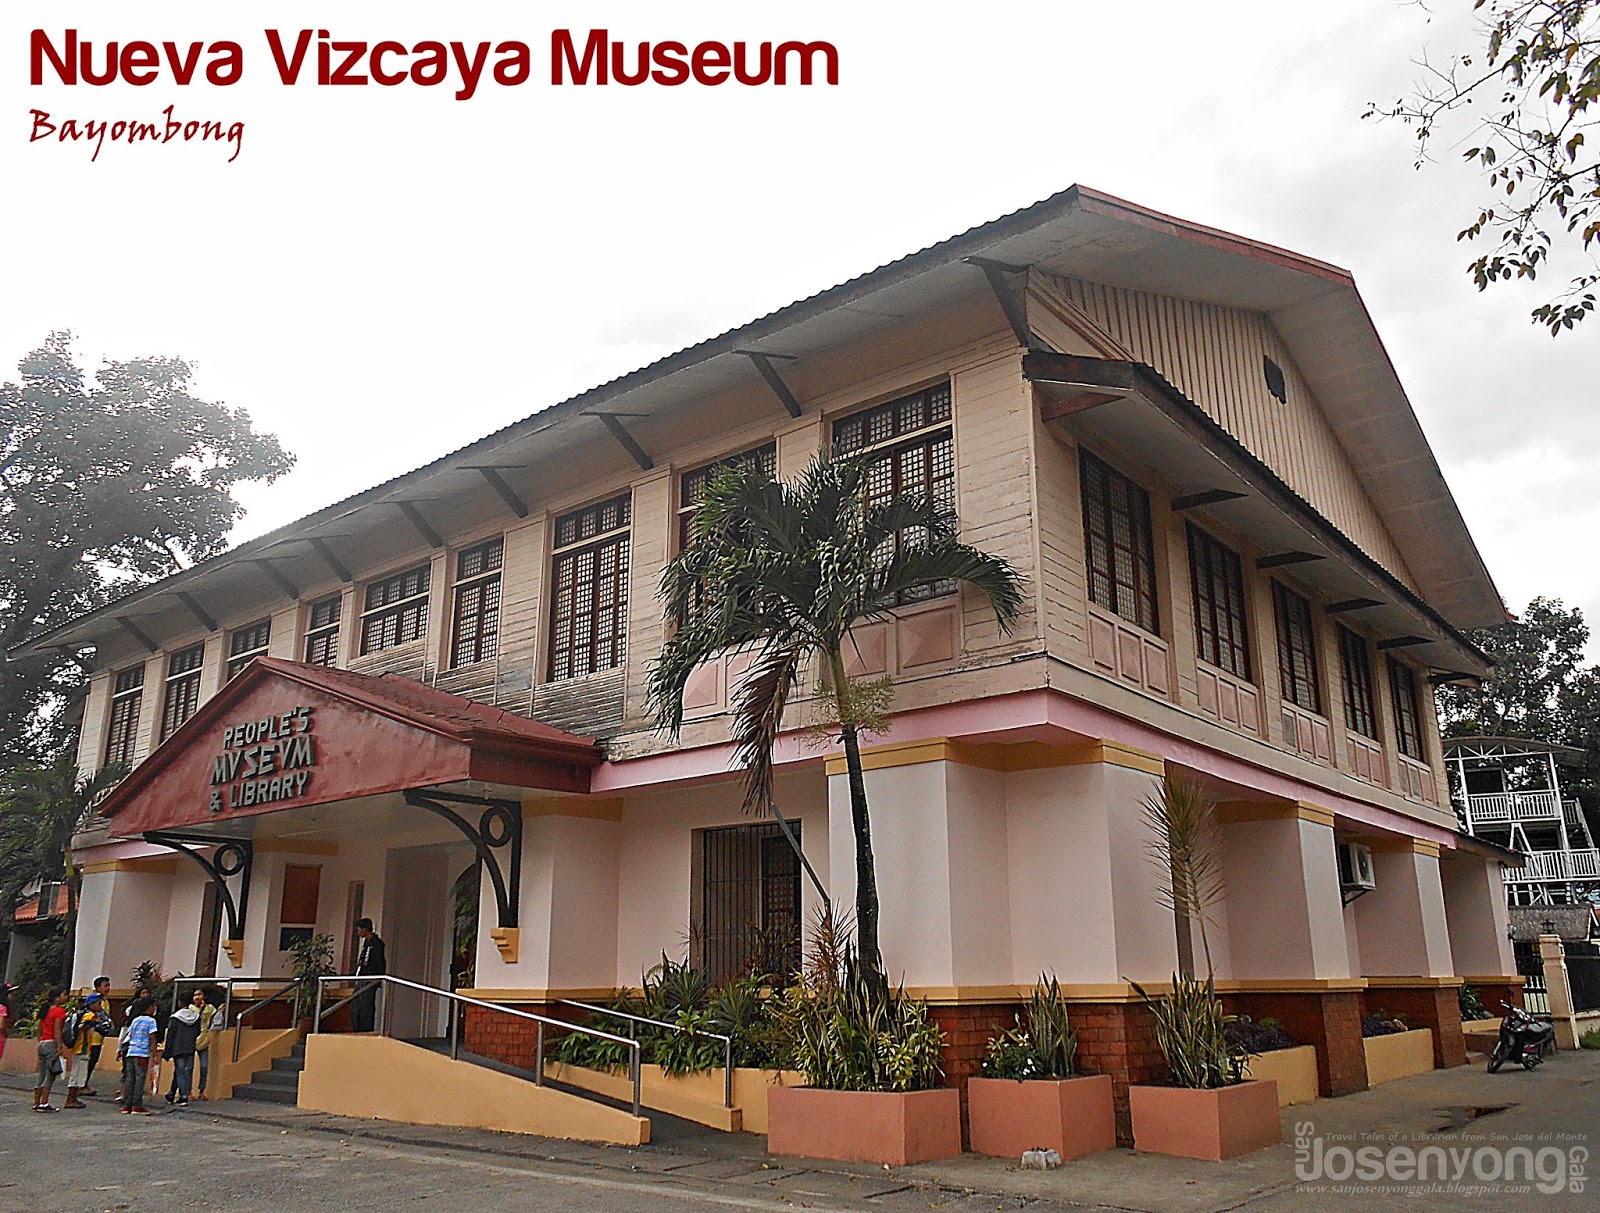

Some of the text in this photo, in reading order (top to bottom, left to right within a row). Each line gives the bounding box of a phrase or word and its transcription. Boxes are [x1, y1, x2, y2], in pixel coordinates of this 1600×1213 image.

[223, 706, 312, 750] PEOPLE'S
[209, 771, 310, 812] & LIBRARY
